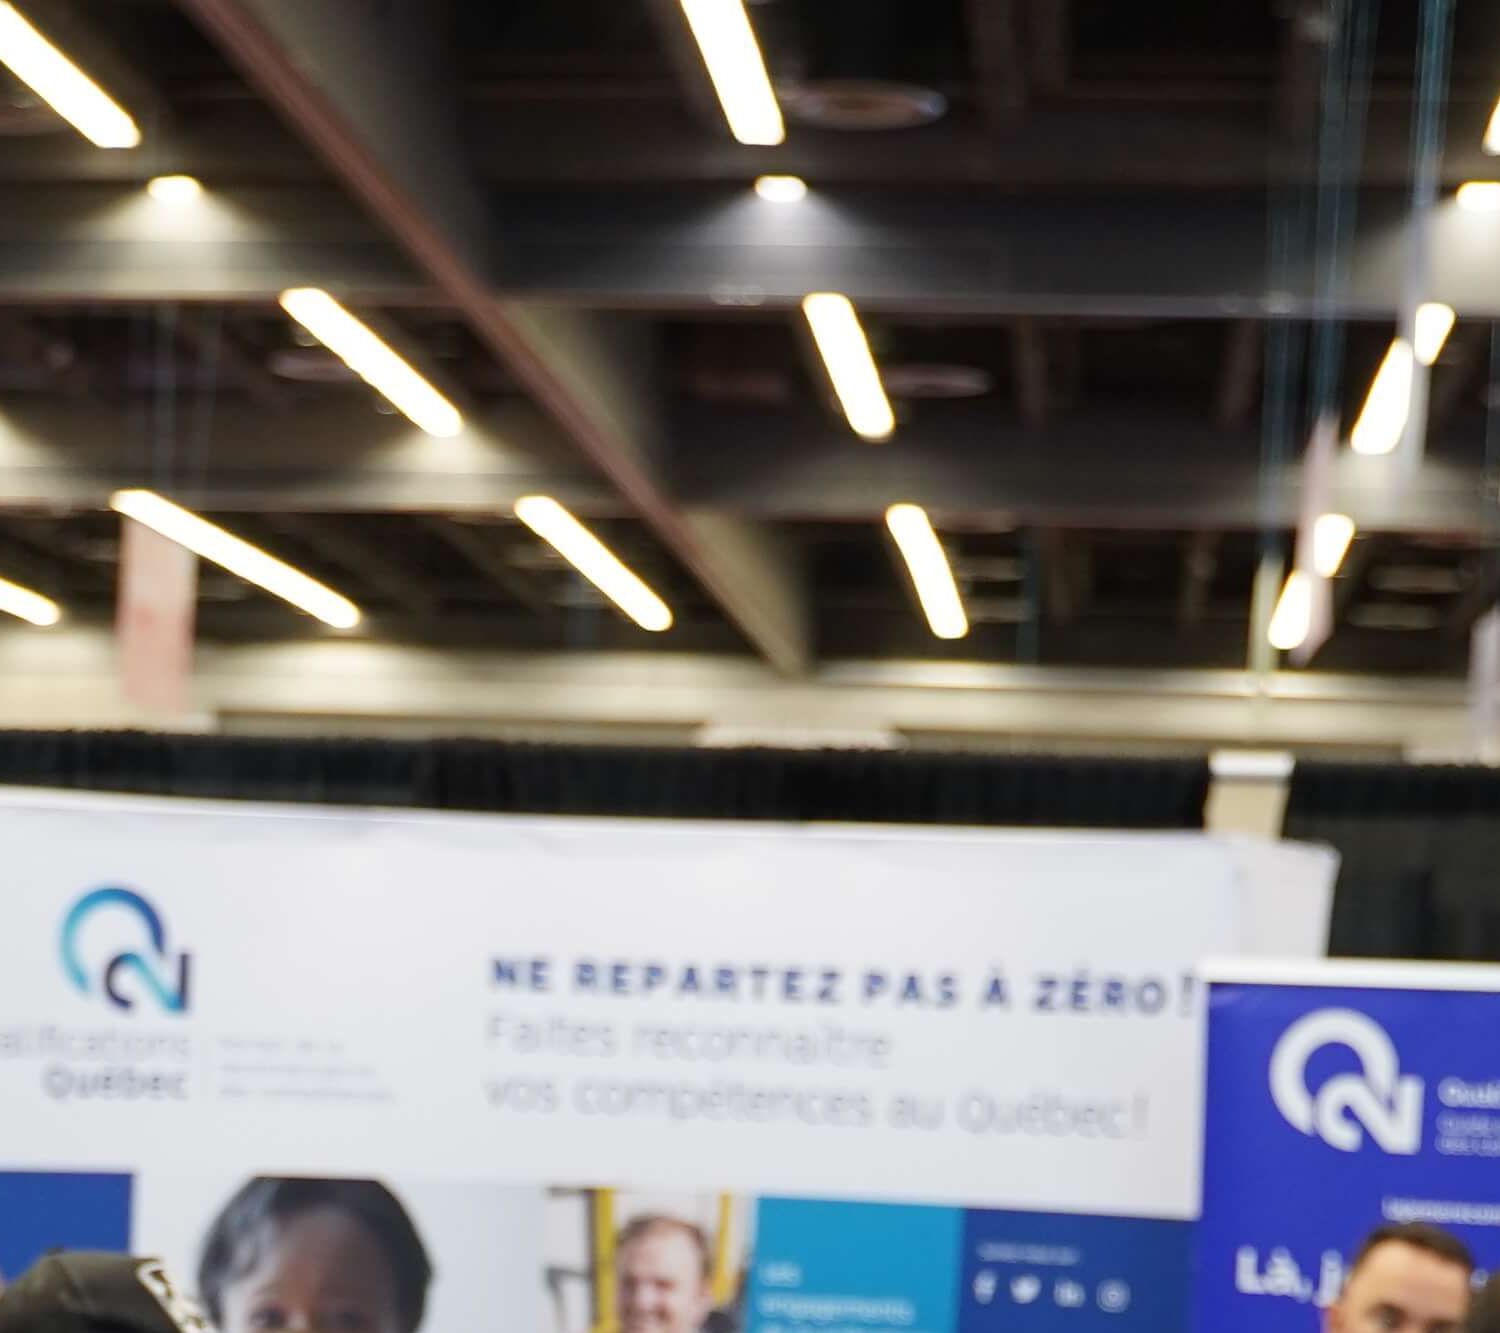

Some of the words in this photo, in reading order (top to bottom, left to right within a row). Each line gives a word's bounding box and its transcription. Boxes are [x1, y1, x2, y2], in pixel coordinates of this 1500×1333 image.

[489, 956, 551, 991] NE
[573, 960, 841, 1004] REPARTEZ
[861, 970, 958, 1008] PAS
[980, 963, 1011, 1012] À
[485, 1014, 617, 1057] Faites
[634, 1018, 893, 1069] reconnaître
[43, 1065, 186, 1100] Québec
[484, 1078, 559, 1114] vos
[573, 1076, 873, 1129] compétences
[886, 1094, 943, 1132] au
